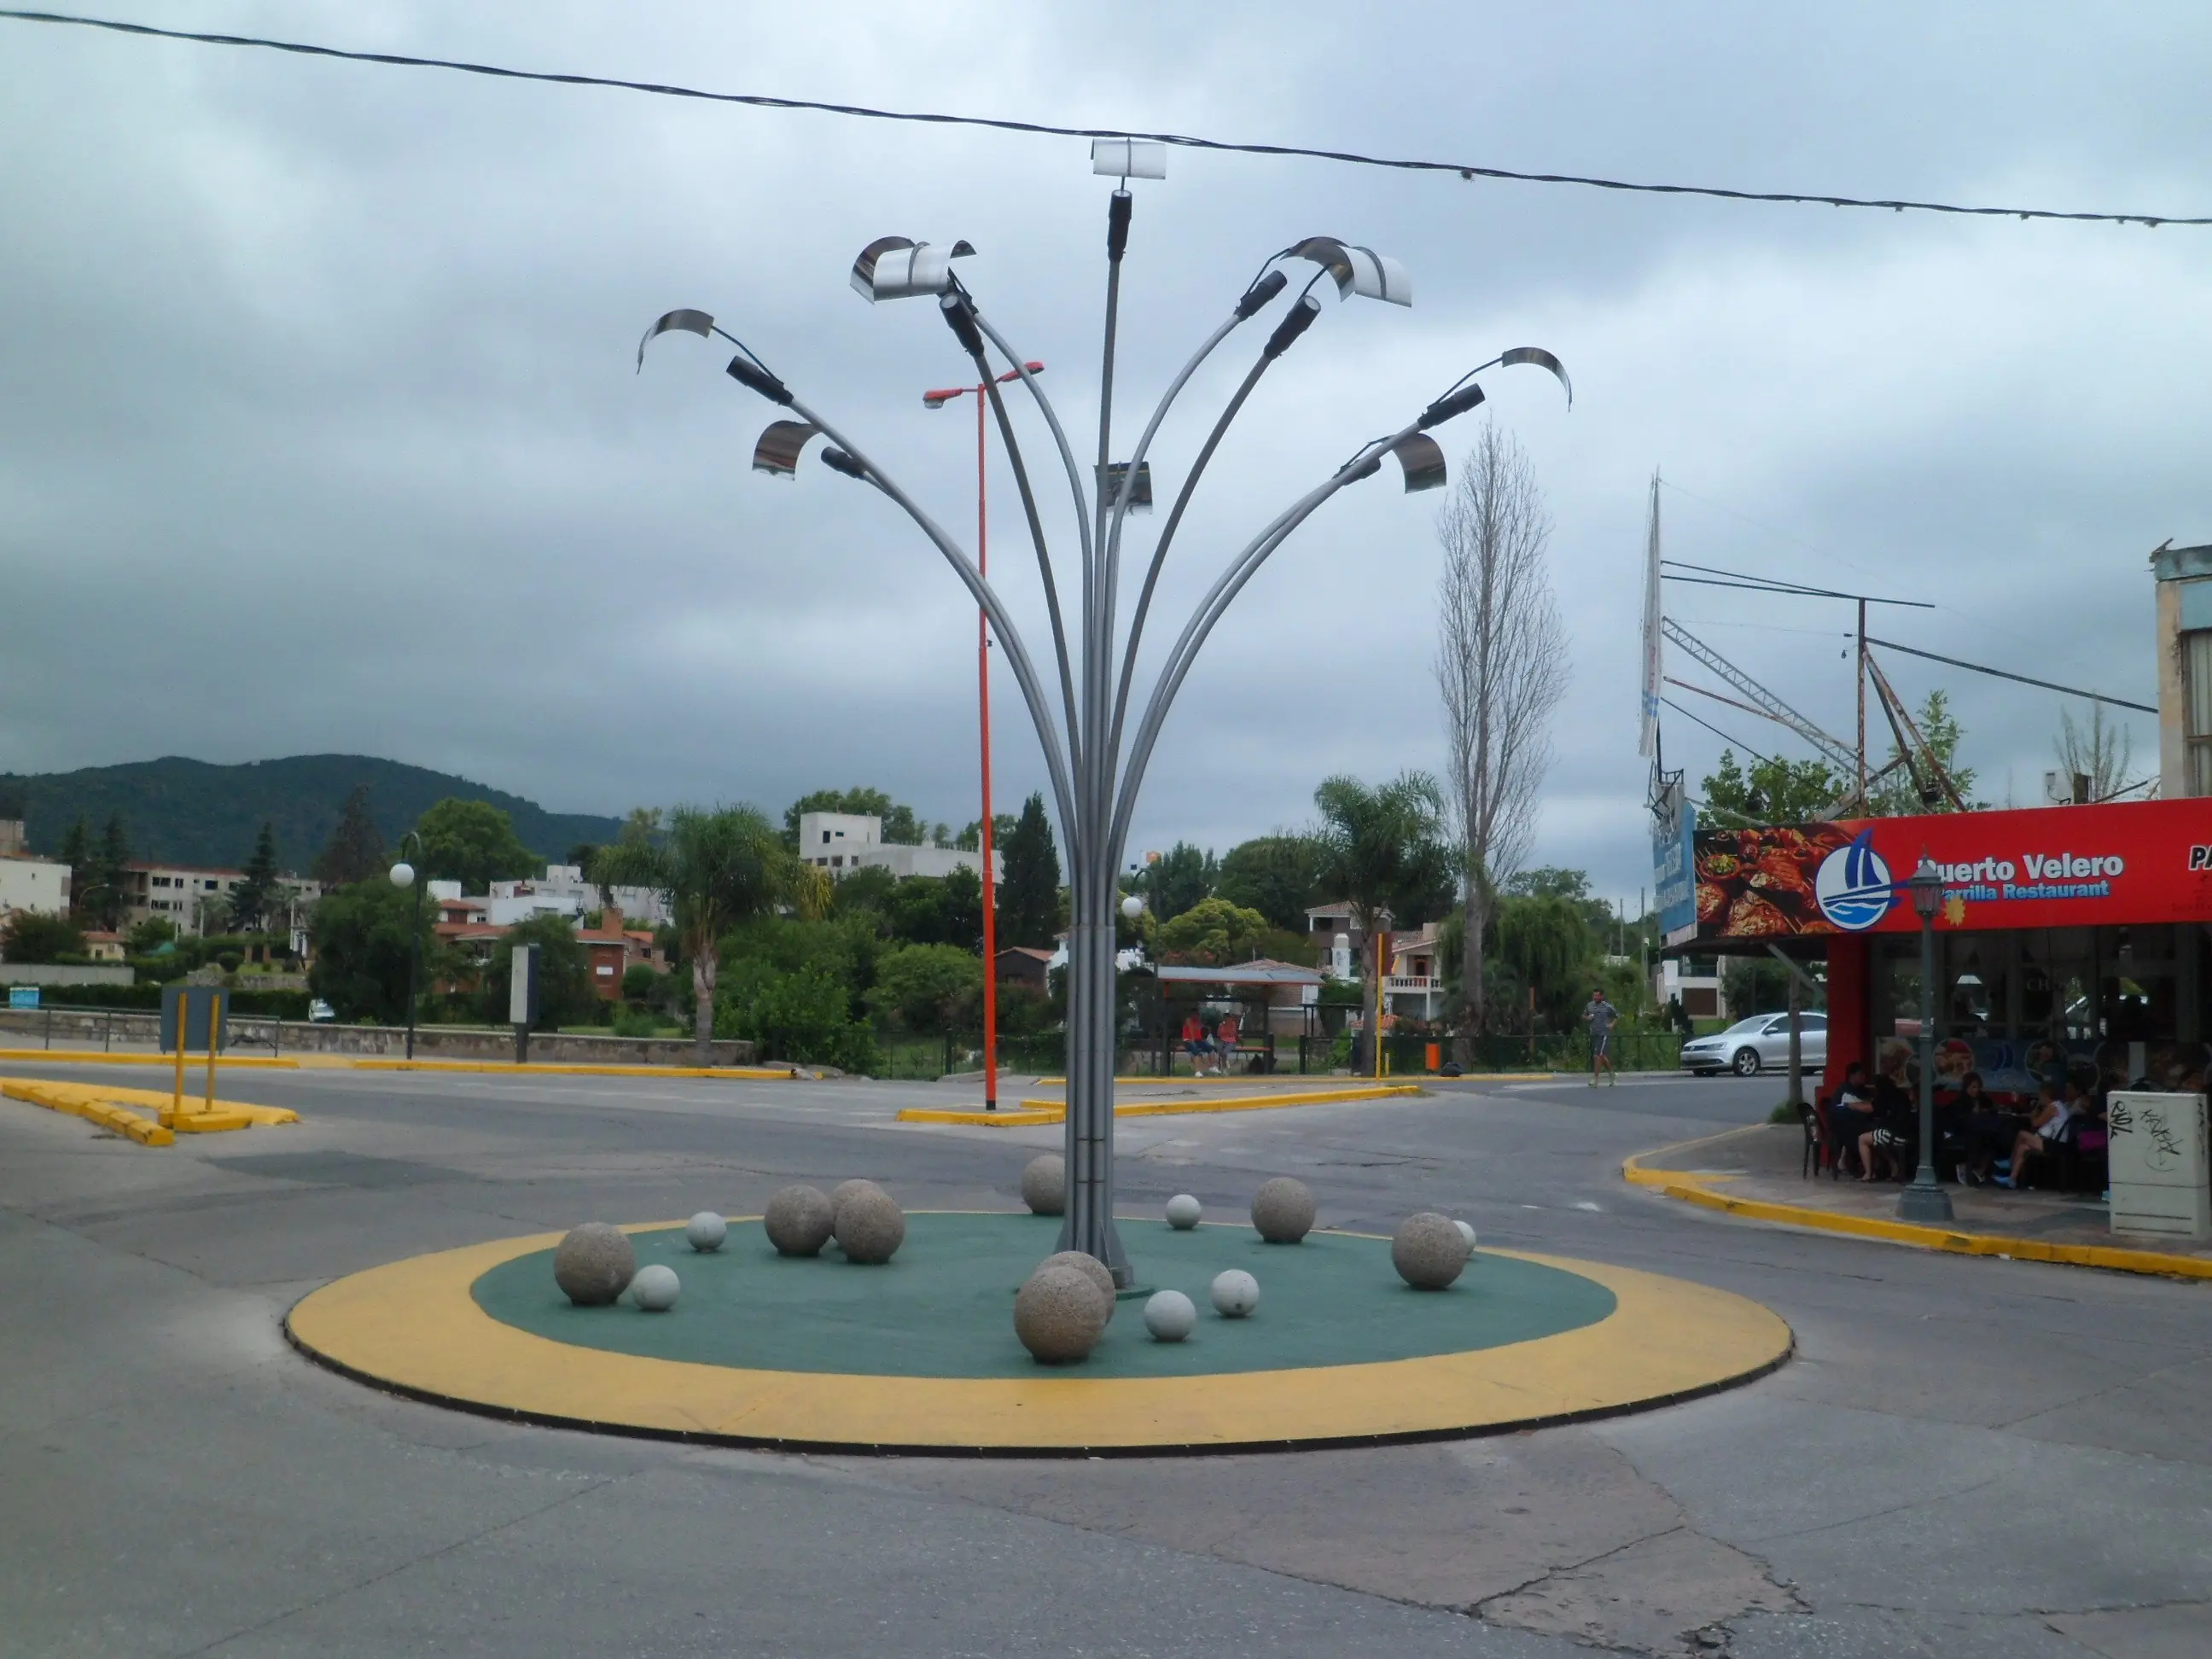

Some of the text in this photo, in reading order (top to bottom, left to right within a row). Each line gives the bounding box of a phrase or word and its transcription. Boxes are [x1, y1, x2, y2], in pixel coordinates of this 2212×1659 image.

[2023, 853, 2123, 879] Velero
[1941, 880, 2110, 901] arrilla Restaurant
